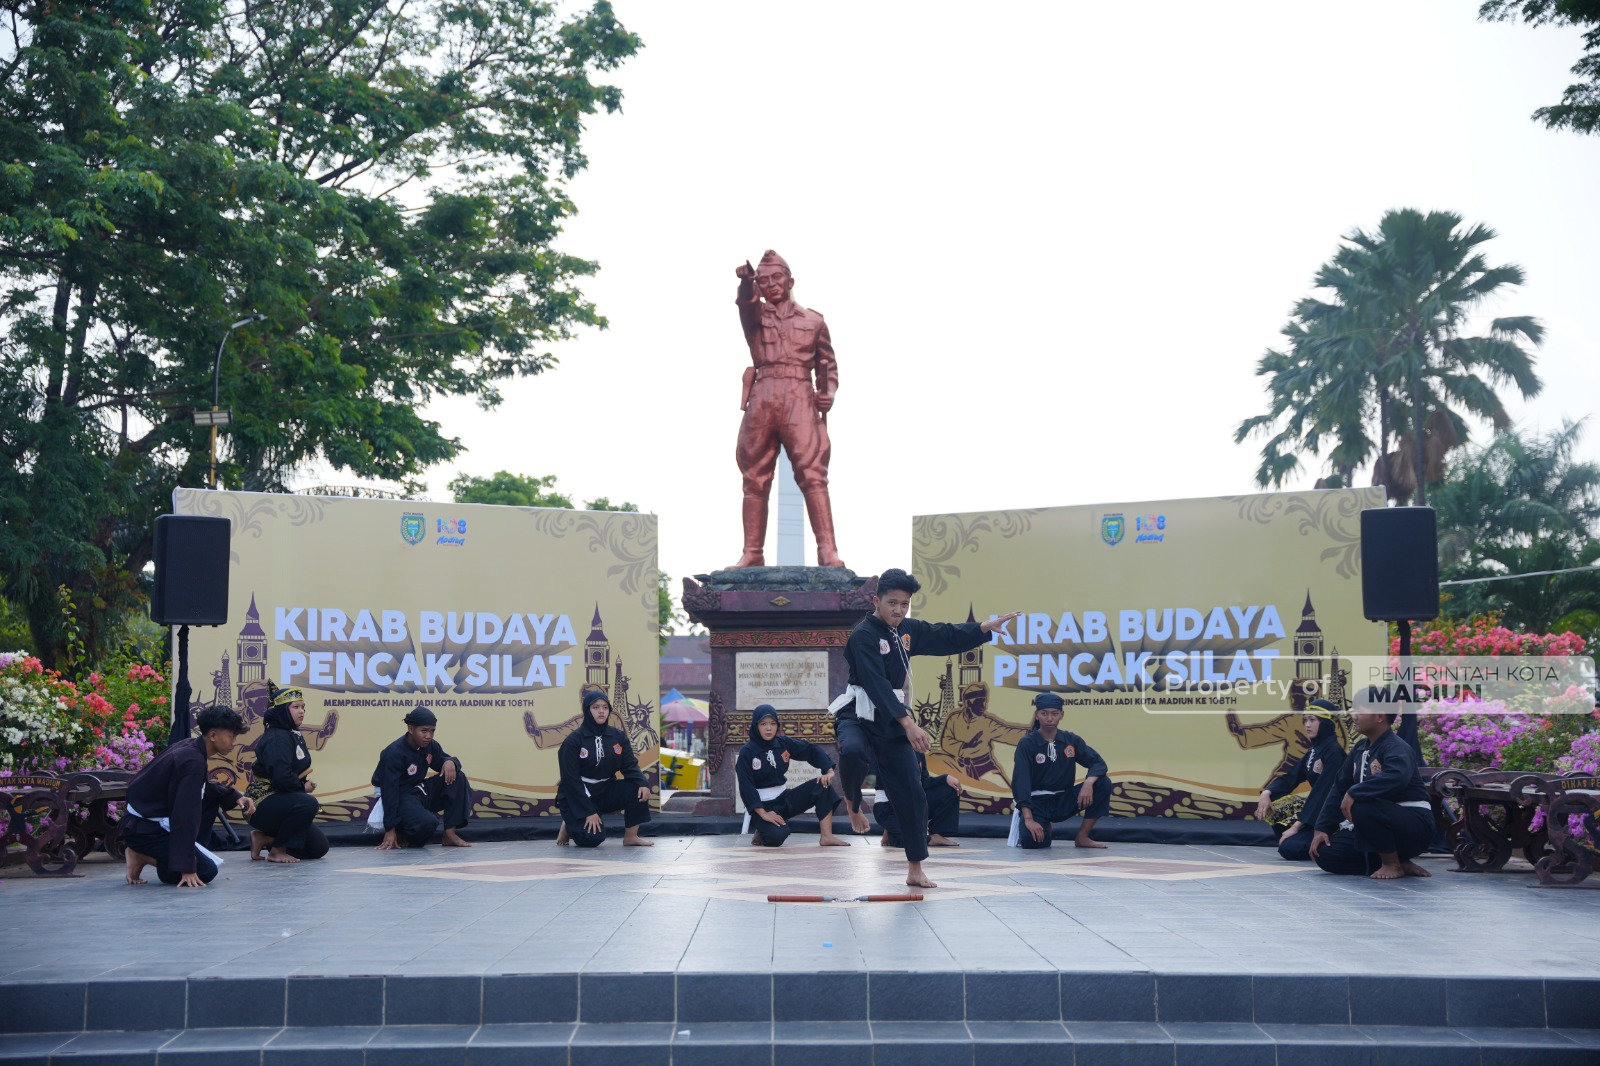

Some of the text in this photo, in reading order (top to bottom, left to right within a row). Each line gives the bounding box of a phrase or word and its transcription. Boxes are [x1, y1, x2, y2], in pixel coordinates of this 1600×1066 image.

[275, 607, 578, 646] KIRAB BUDAYA
[989, 604, 1287, 646] KIRAB BUDAYA
[281, 651, 572, 687] PENCAK SILAT
[993, 649, 1281, 687] PENCAK SILAT
[323, 699, 390, 707] MEMPERINGATI
[435, 699, 457, 707] KOTA
[460, 699, 493, 707] MADIUN
[494, 699, 506, 707] KE
[508, 699, 535, 707] 108TH
[1093, 698, 1113, 706] HARI
[1115, 698, 1133, 706] JADI
[1159, 697, 1194, 705] MADIUN
[1209, 696, 1237, 704] 108TH
[1561, 779, 1587, 790] DINAS
